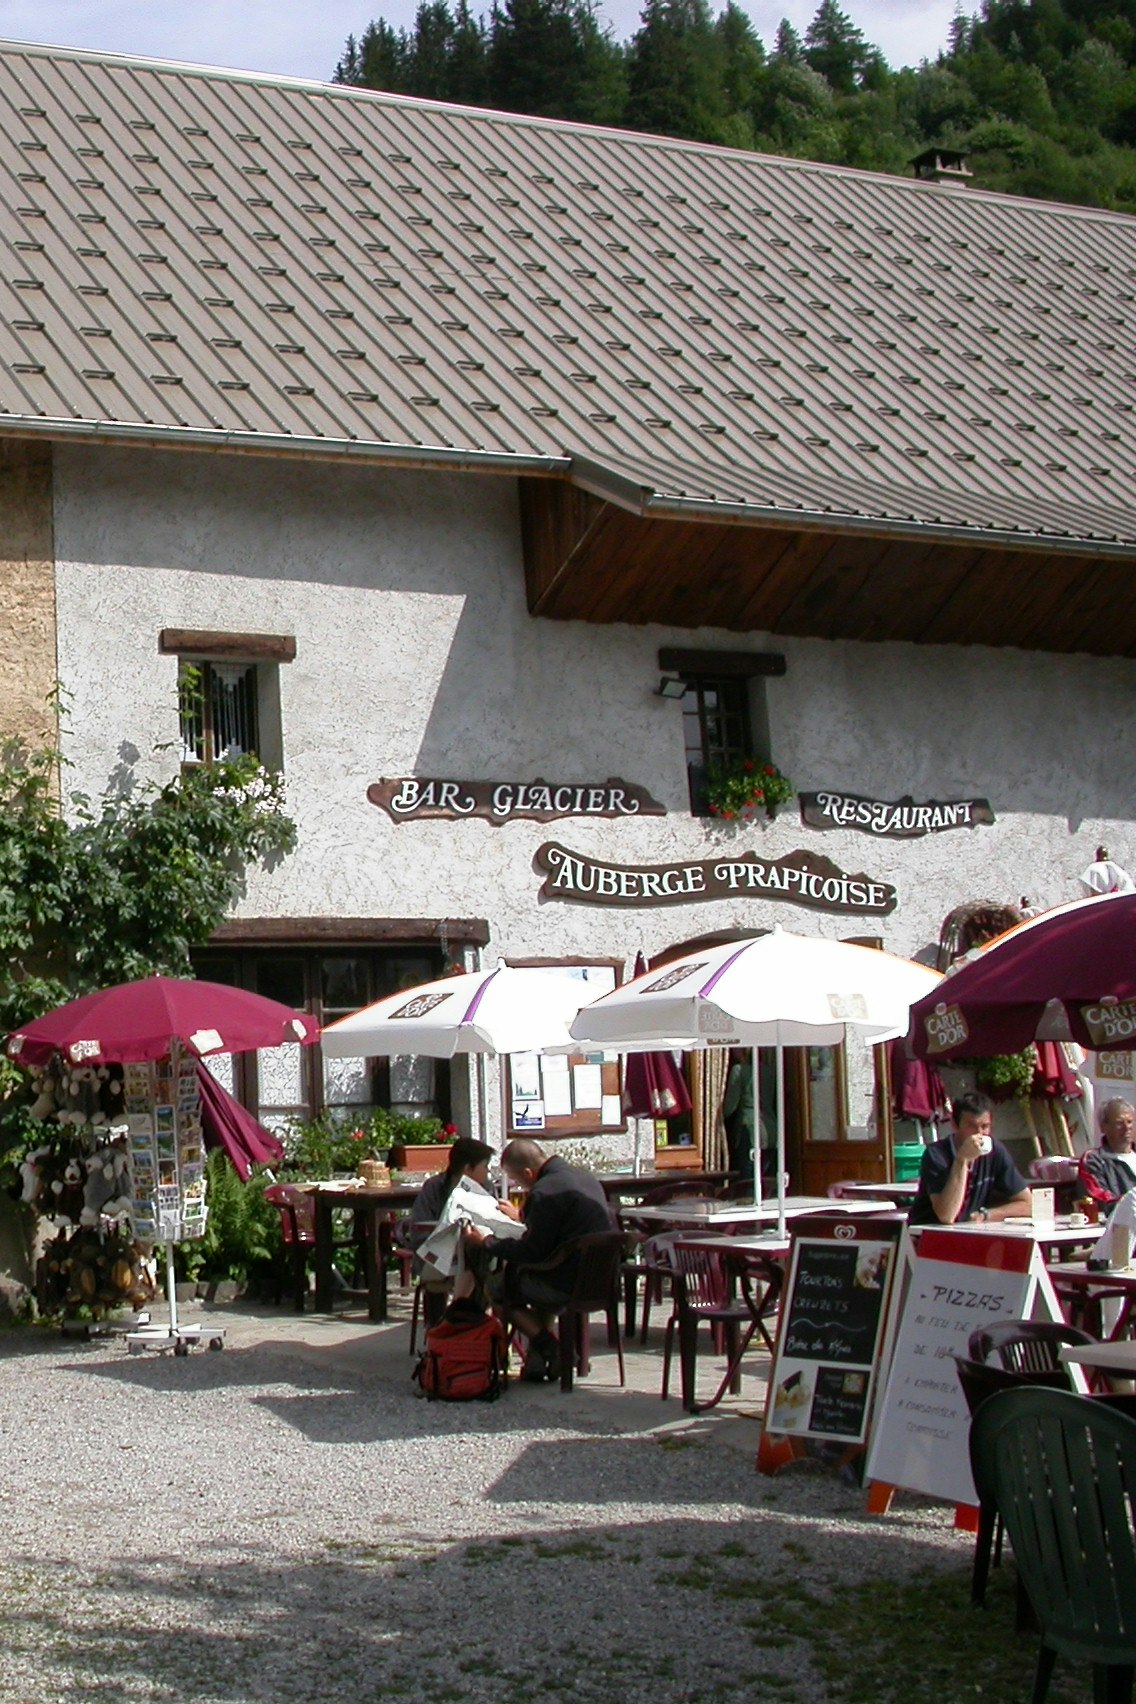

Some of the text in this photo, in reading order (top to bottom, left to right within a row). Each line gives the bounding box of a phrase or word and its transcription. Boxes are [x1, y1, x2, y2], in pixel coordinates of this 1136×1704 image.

[391, 781, 640, 816] BAR GLACIER
[817, 792, 973, 833] RESTAURANT
[548, 848, 887, 907] AUBERGE PRAPICOISE
[927, 1010, 962, 1034] CARTE
